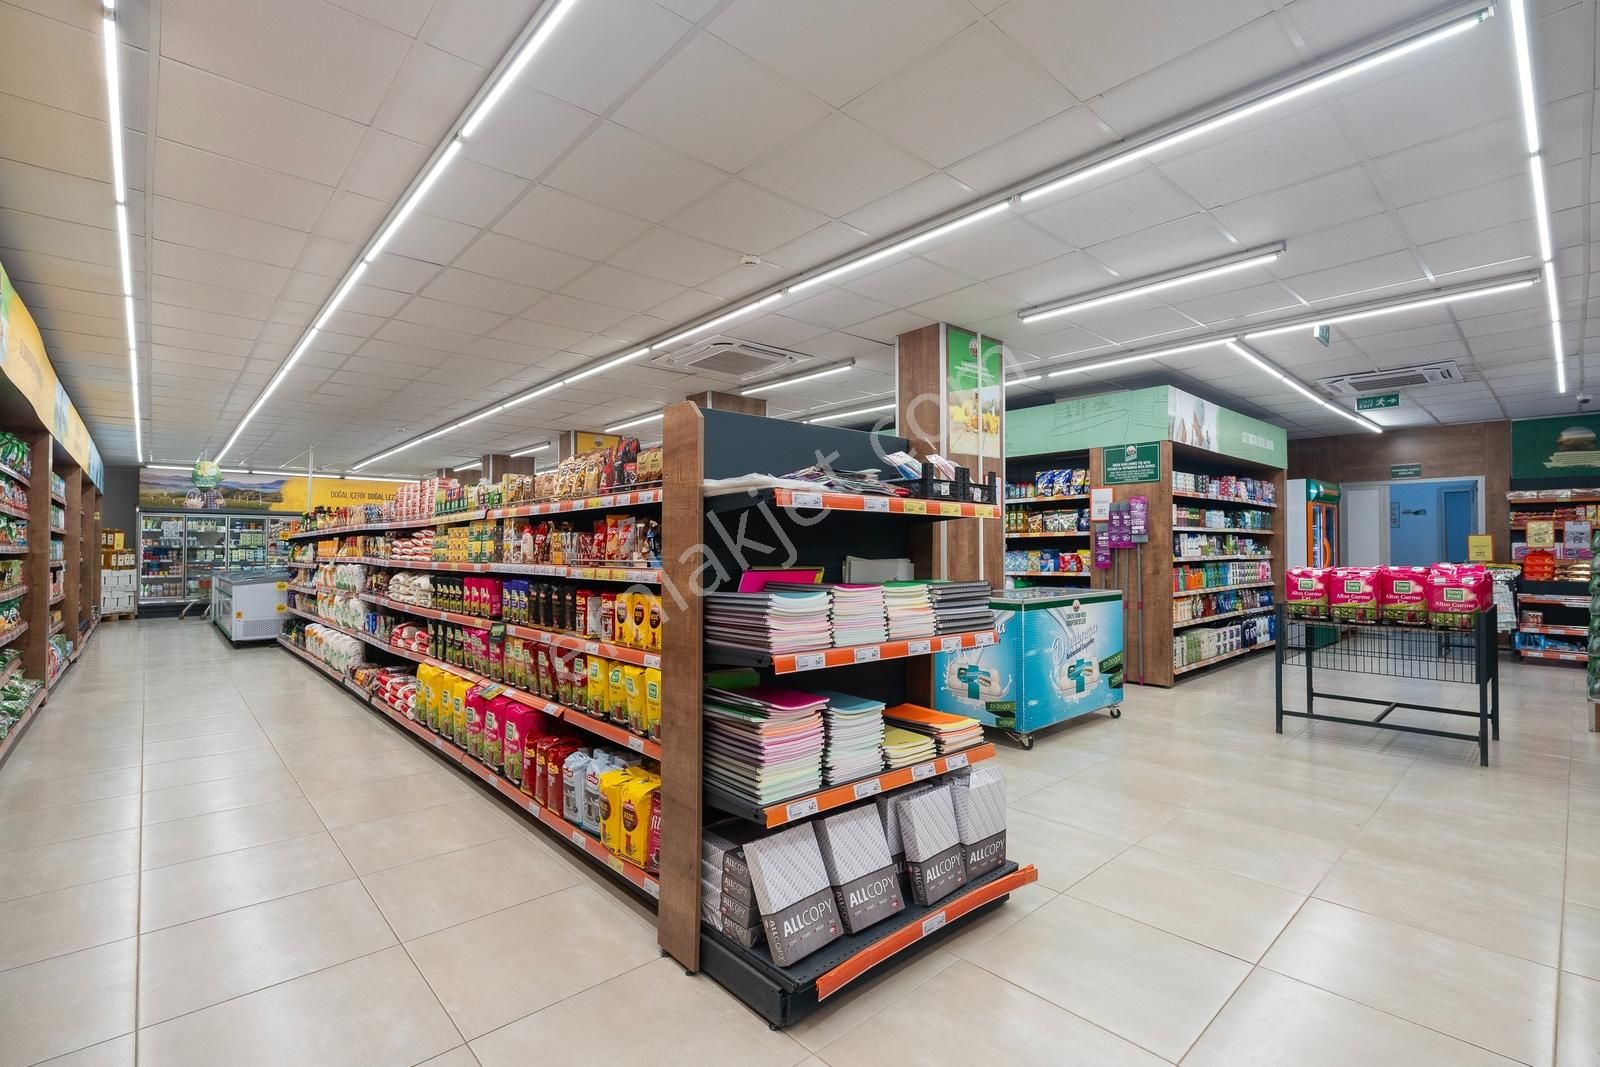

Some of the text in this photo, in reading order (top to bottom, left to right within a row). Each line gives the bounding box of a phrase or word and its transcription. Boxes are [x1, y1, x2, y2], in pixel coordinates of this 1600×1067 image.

[970, 839, 1006, 865] ALLCOPY
[725, 857, 749, 878] ALLCOPY
[926, 852, 962, 884] ALLCOPY
[724, 876, 748, 898] ALLCOPY
[850, 874, 896, 908] ALLCOPY
[723, 896, 746, 919] ALLCOPY
[783, 898, 833, 938] ALLCOPY
[768, 919, 786, 963] ALLCOPY
